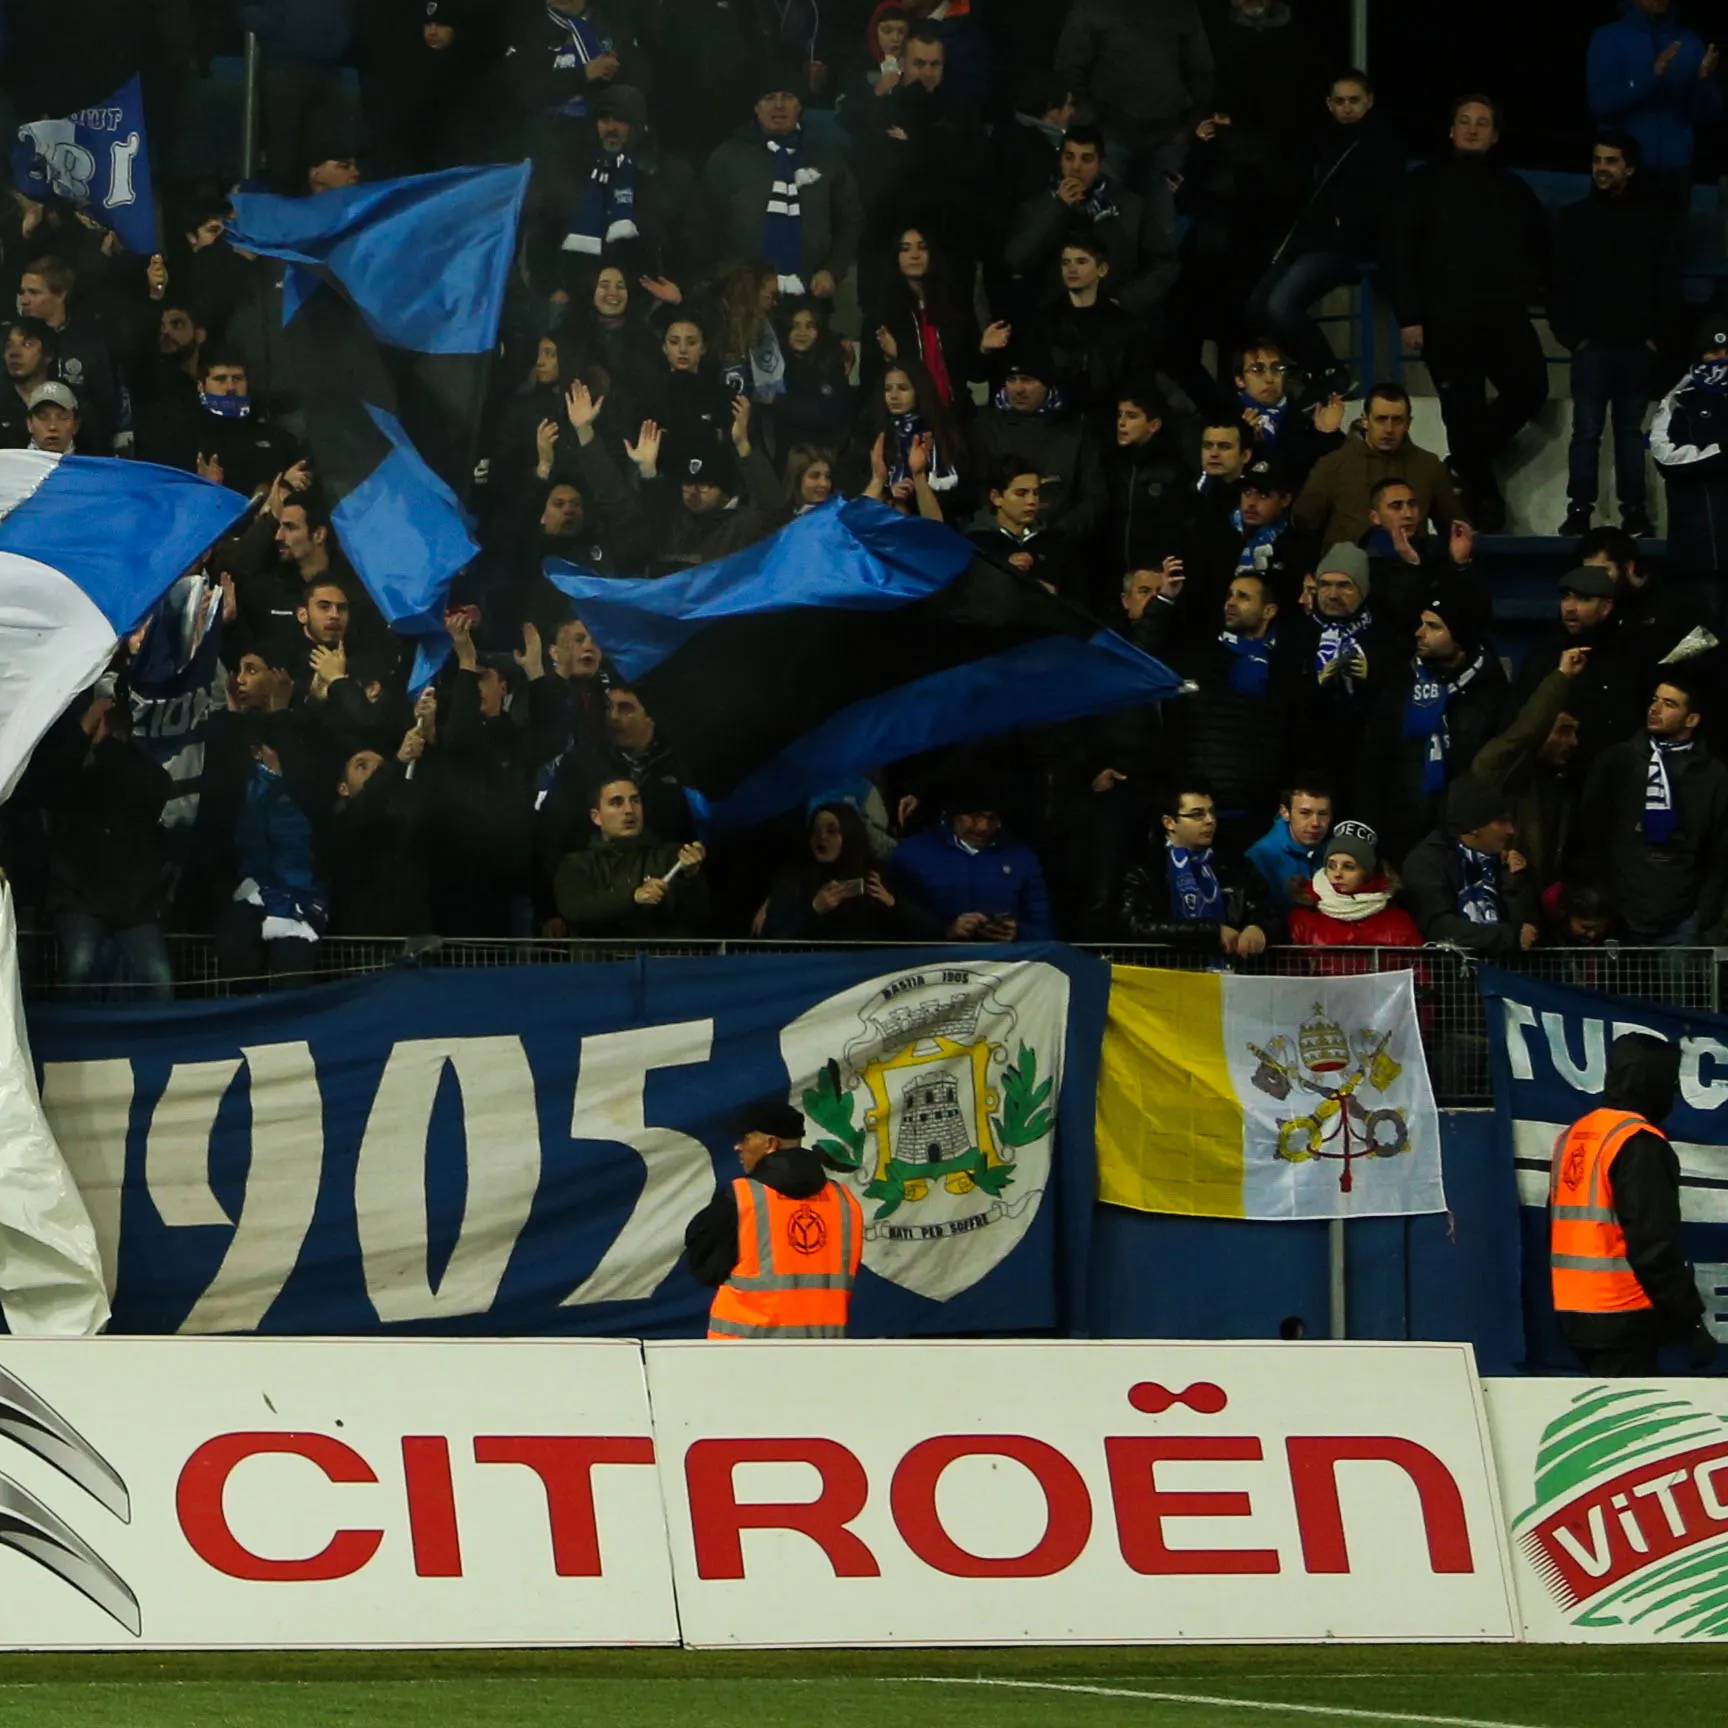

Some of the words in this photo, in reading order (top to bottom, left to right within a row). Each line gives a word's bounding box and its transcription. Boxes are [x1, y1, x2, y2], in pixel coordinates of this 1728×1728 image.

[1412, 683, 1440, 701] SCB
[881, 975, 926, 1001] BASTIA
[941, 971, 969, 985] 1905
[1502, 997, 1728, 1111] TUC
[43, 1018, 716, 1334] 1905
[921, 1225, 944, 1239] PER
